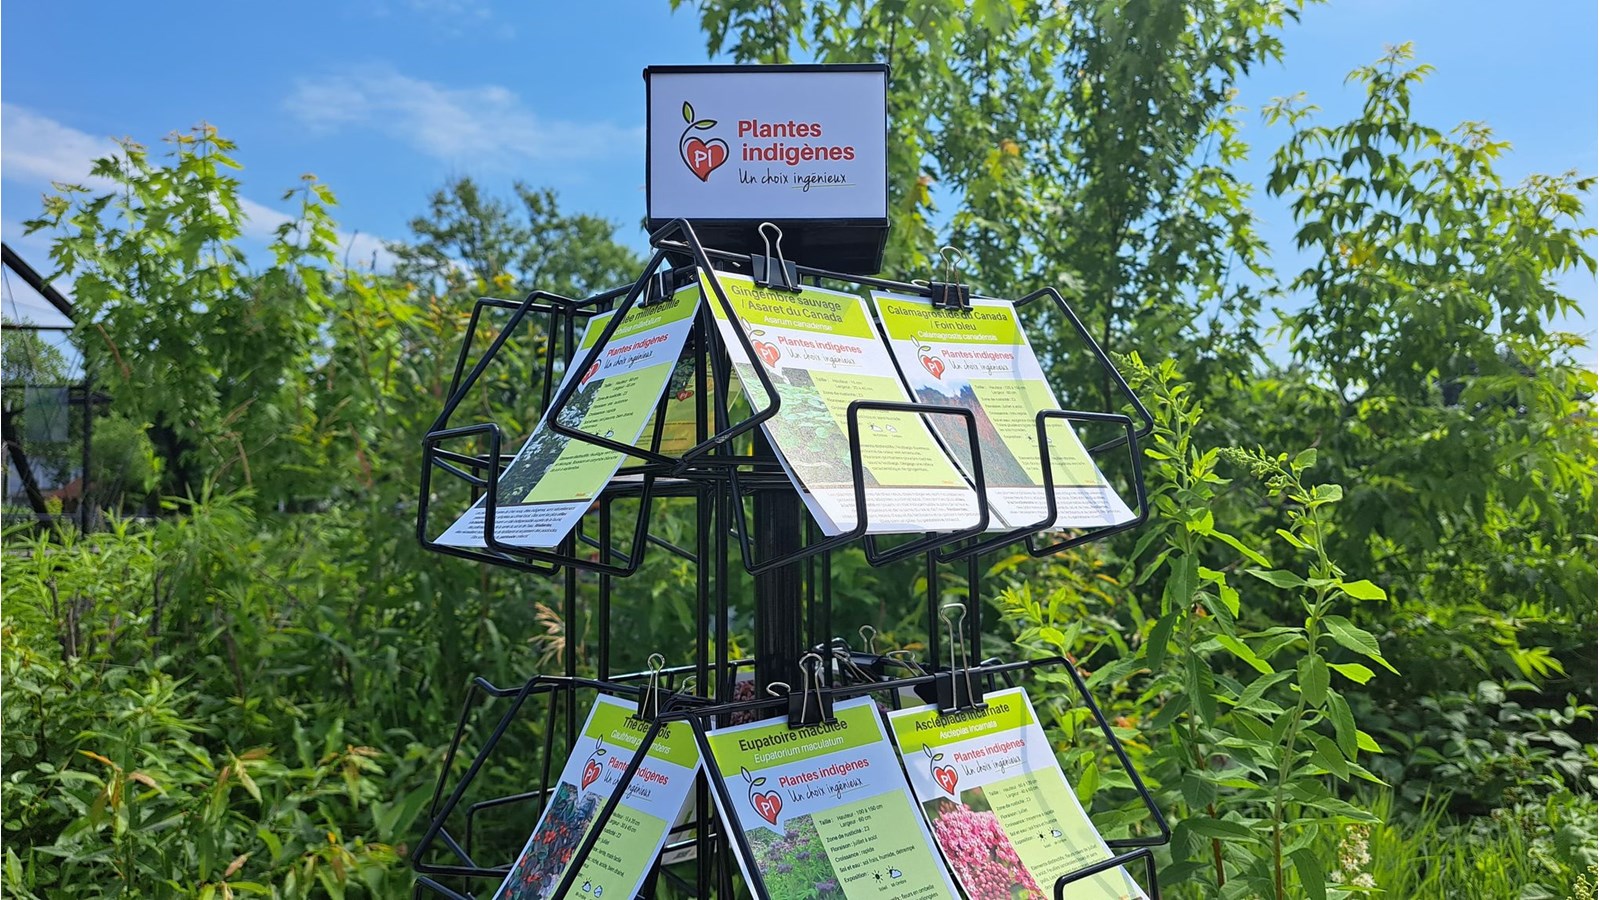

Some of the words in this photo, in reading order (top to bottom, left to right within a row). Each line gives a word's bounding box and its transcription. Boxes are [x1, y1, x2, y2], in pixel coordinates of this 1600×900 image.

[738, 119, 822, 138] Plantes
[694, 150, 712, 168] PI
[743, 143, 855, 166] indigènes
[738, 168, 757, 184] Un
[761, 168, 789, 184] choix
[793, 171, 847, 192] ingénieux
[731, 285, 796, 305] Gingembre
[798, 296, 842, 312] sauvage
[748, 301, 784, 315] Asaret
[786, 306, 801, 317] du
[803, 309, 843, 323] Canada
[887, 305, 959, 319] Calamagrostide
[974, 312, 1007, 321] Canada
[934, 321, 956, 331] Foin
[957, 322, 976, 331] bleu
[607, 345, 632, 357] Plantes
[778, 336, 815, 349] Plantes
[816, 339, 862, 354] indigènes
[941, 349, 973, 359] Plantes
[915, 713, 967, 731] Asclépiade
[968, 703, 1010, 719] incarnate
[658, 727, 671, 739] ois
[739, 732, 797, 751] Eupatoire
[940, 727, 969, 739] Asclepias
[754, 747, 800, 764] Eupatorium
[801, 736, 844, 752] maculatum
[954, 749, 985, 763] Plantes
[986, 739, 1025, 754] indigènes
[636, 766, 669, 785] ndigènes
[779, 771, 819, 788] Plantes
[819, 759, 869, 778] indigènes
[788, 789, 805, 803] Un
[806, 784, 825, 799] choix
[827, 778, 863, 799] ingénieux
[760, 800, 776, 816] PI
